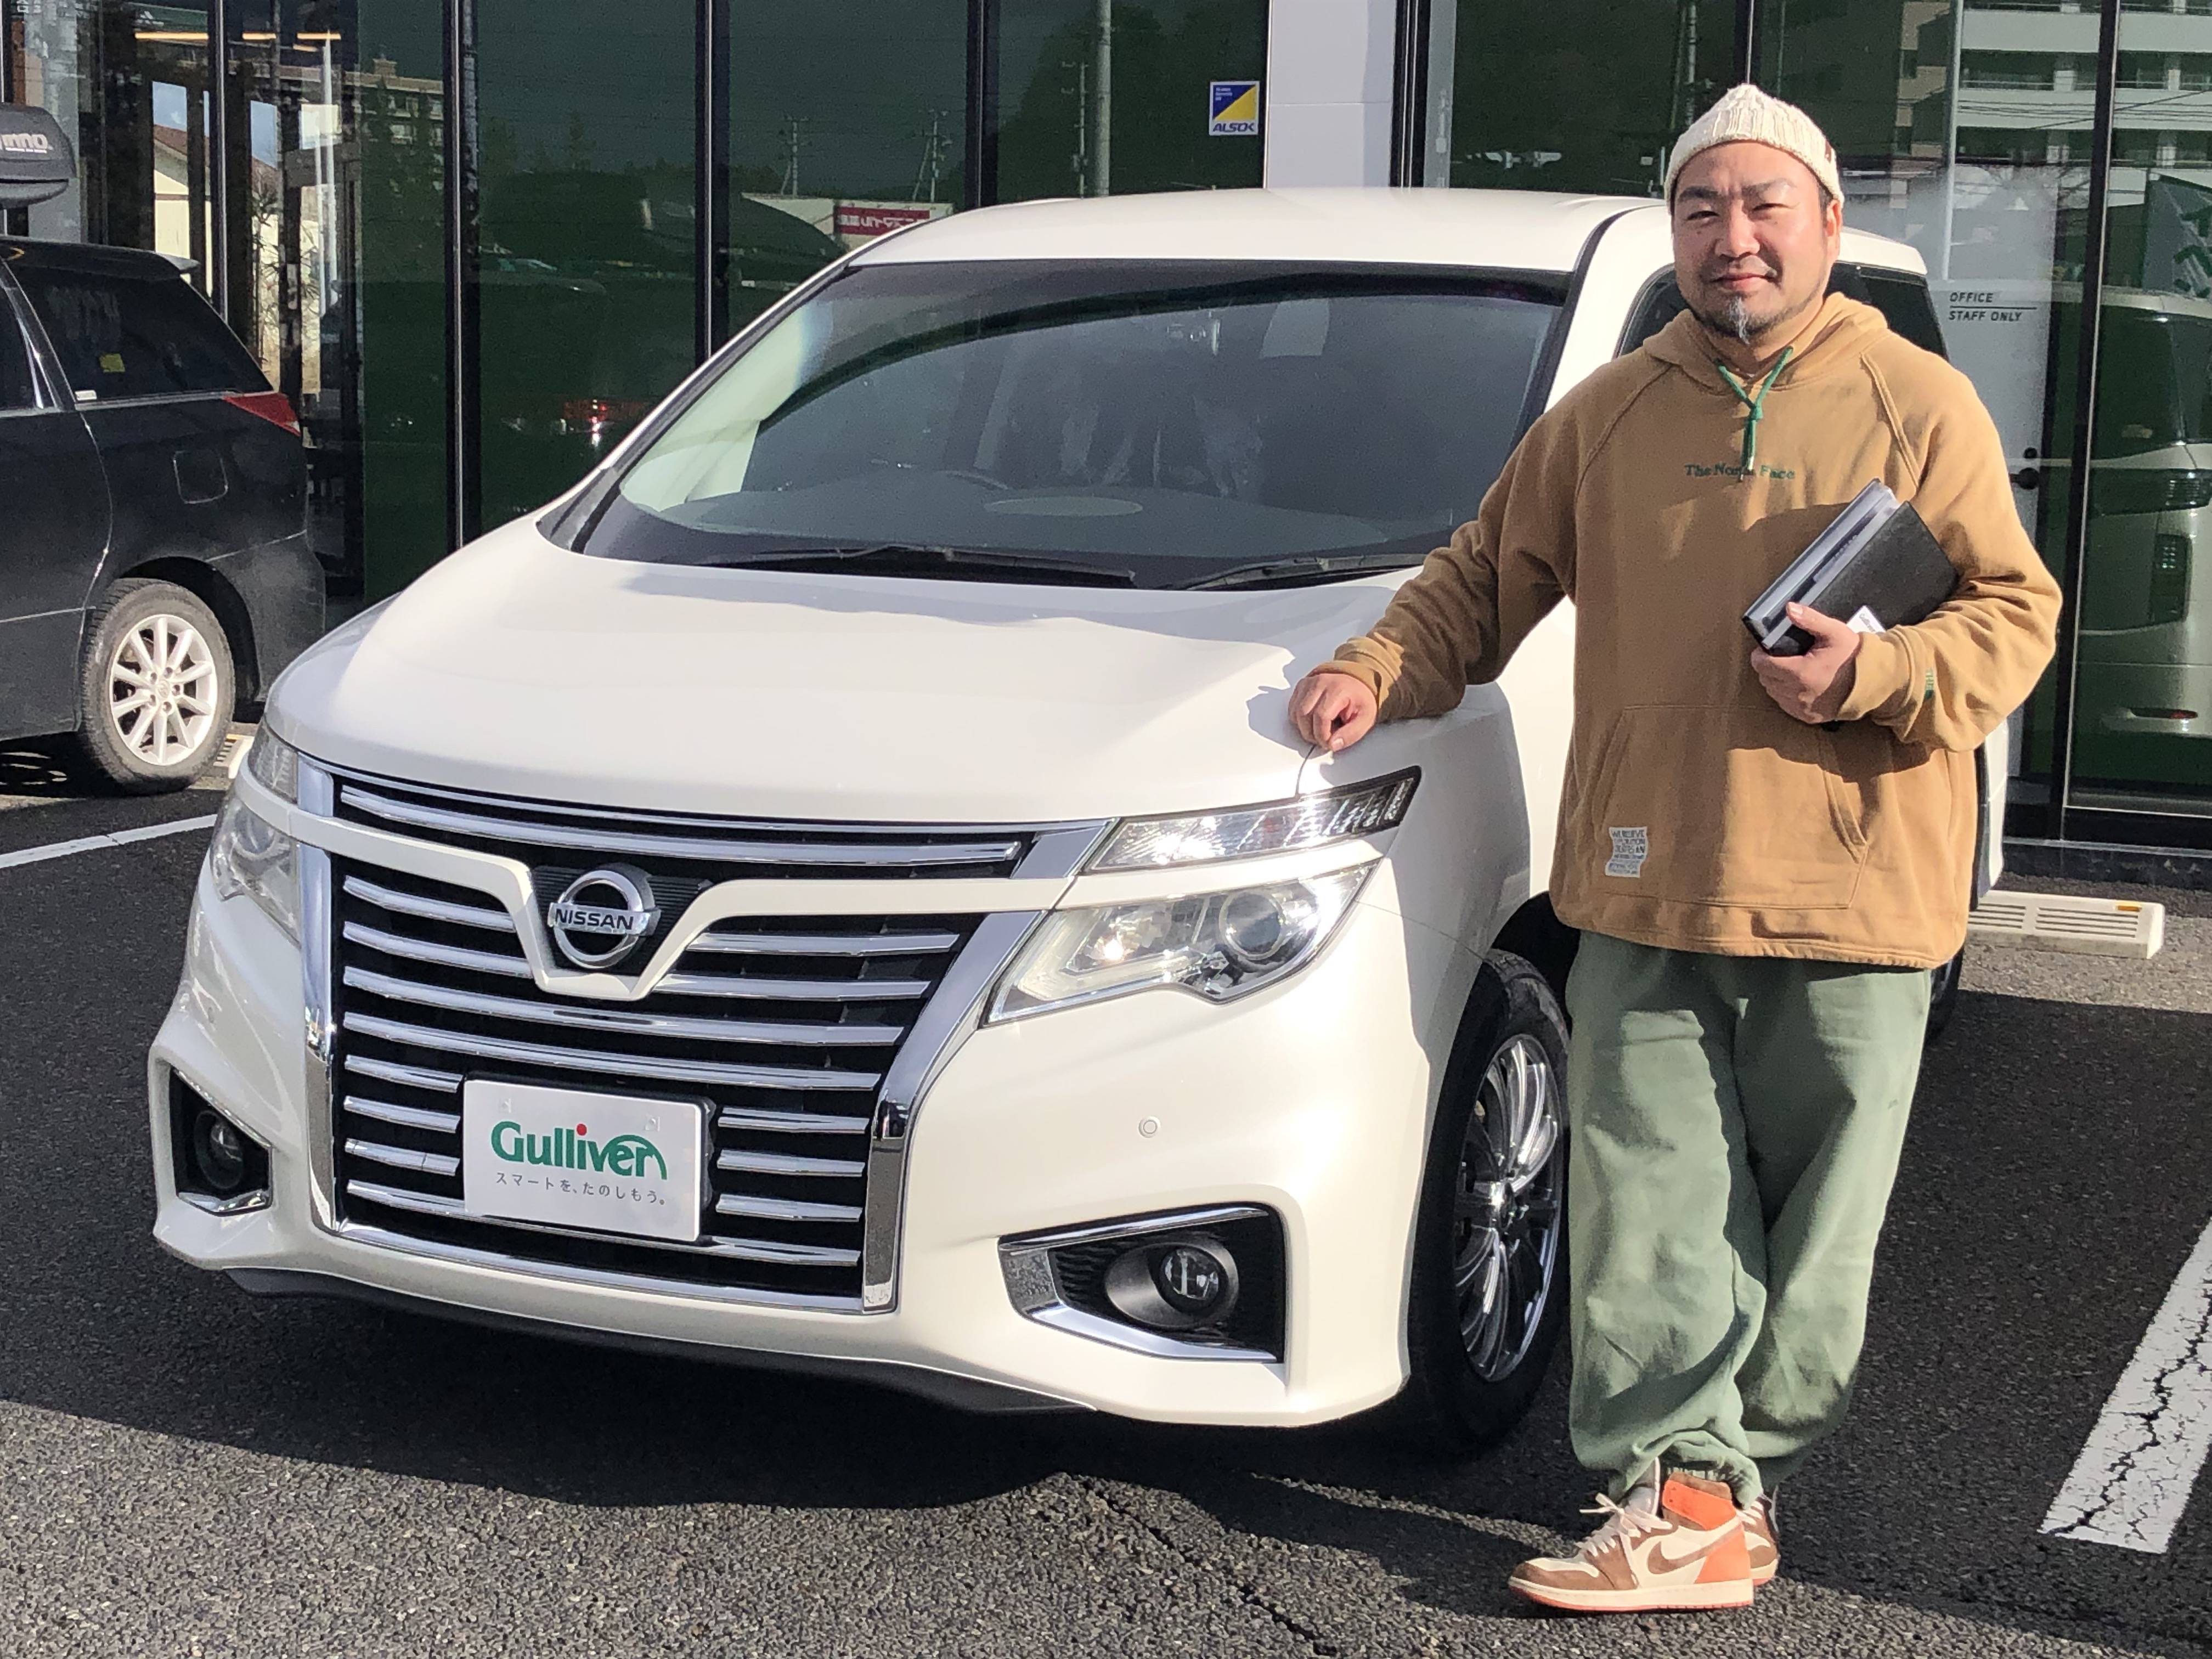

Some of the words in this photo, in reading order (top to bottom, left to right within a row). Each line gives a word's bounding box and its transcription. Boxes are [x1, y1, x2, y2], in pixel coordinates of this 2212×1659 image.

[1212, 122, 1255, 132] ALSOK
[1949, 291, 1994, 303] OFFICE
[1948, 310, 1987, 321] STAFF
[1990, 311, 2022, 322] ONLY
[1684, 464, 1711, 477] The
[1760, 465, 1795, 479] Face
[555, 908, 634, 930] NISSAN
[490, 1120, 667, 1180] Gulliver
[496, 1172, 665, 1205] スマートを、たのしもう。
